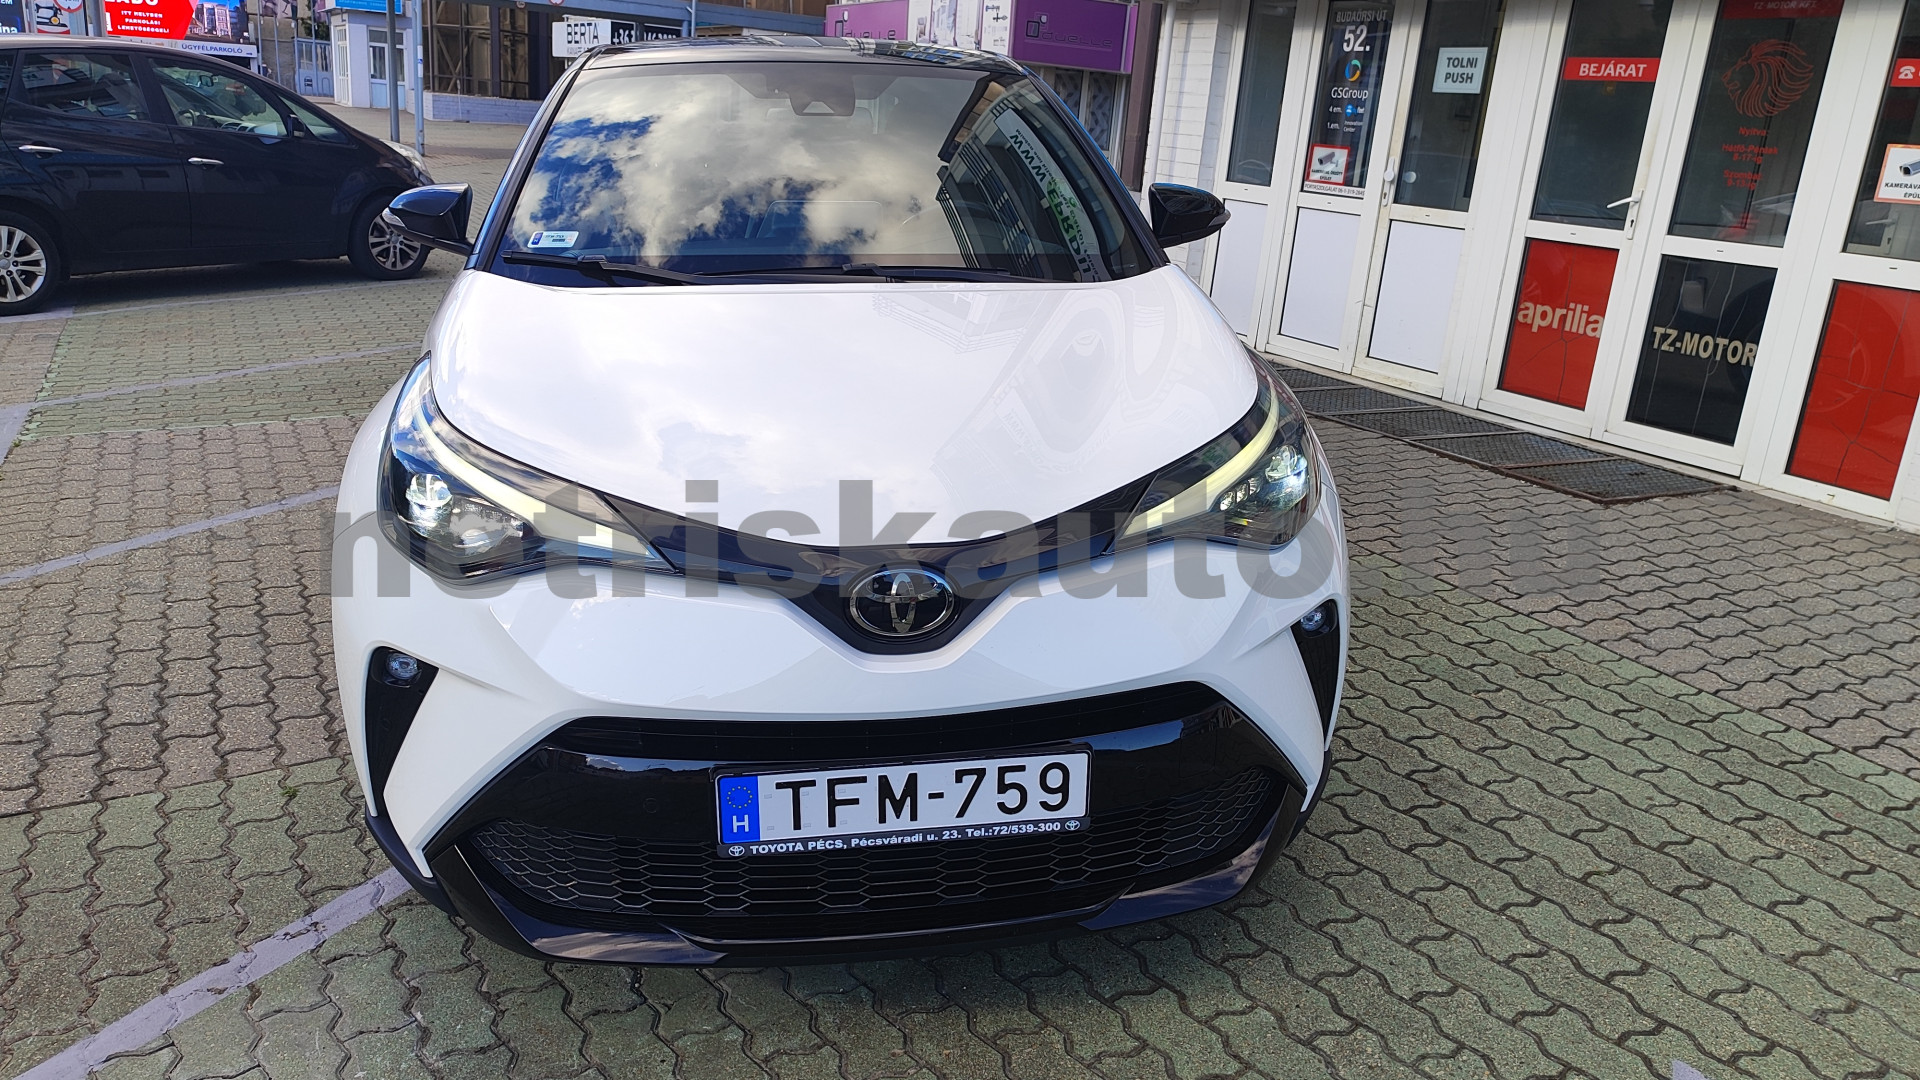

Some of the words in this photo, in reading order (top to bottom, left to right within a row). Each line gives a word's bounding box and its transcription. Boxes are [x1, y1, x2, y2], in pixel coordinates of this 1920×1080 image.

[566, 22, 600, 44] BERTA
[1343, 24, 1371, 52] 52.
[181, 43, 243, 54] ÜGYFÉLPARKOLÓ
[1446, 56, 1478, 69] TOLNI
[1578, 60, 1648, 77] BEJÁRAT
[1443, 72, 1474, 84] PUSH
[1331, 87, 1369, 101] GSGroup
[1517, 301, 1604, 338] aprilia
[1652, 326, 1759, 367] TZ-MOTOR
[775, 762, 1070, 831] TFM-759
[732, 814, 750, 833] H
[749, 840, 804, 855] TOYOTA
[807, 837, 848, 851] PÉCS,
[851, 832, 924, 848] Pécsváradi
[925, 832, 939, 842] u.
[941, 829, 963, 840] 23.
[964, 820, 1062, 838] Tel.:72/539-300
